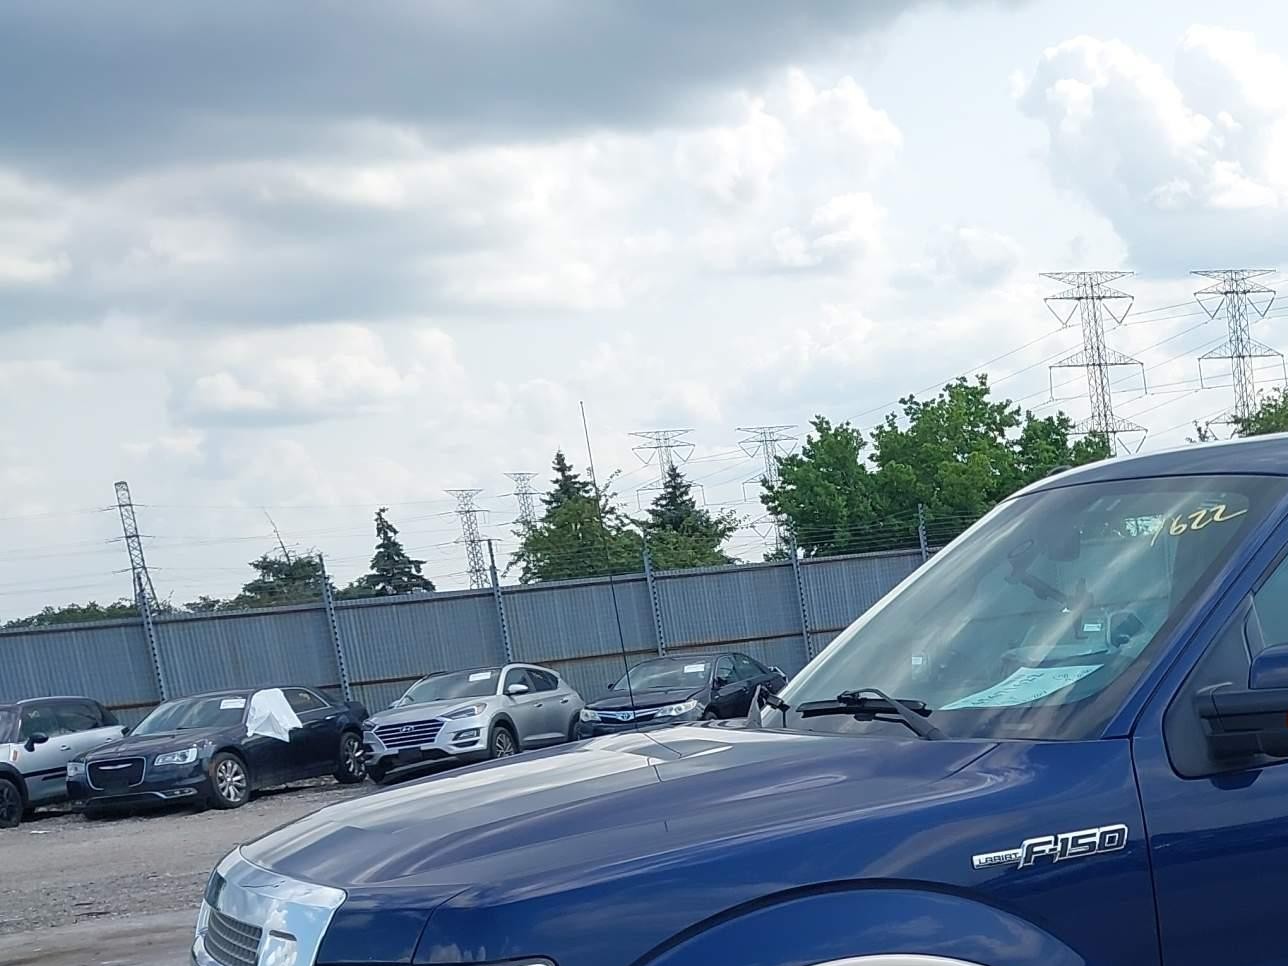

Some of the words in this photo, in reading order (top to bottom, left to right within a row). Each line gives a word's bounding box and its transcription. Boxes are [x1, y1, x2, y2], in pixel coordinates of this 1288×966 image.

[1150, 503, 1248, 547] 1622
[977, 851, 1021, 866] LARIAT
[1017, 823, 1129, 869] F-150
